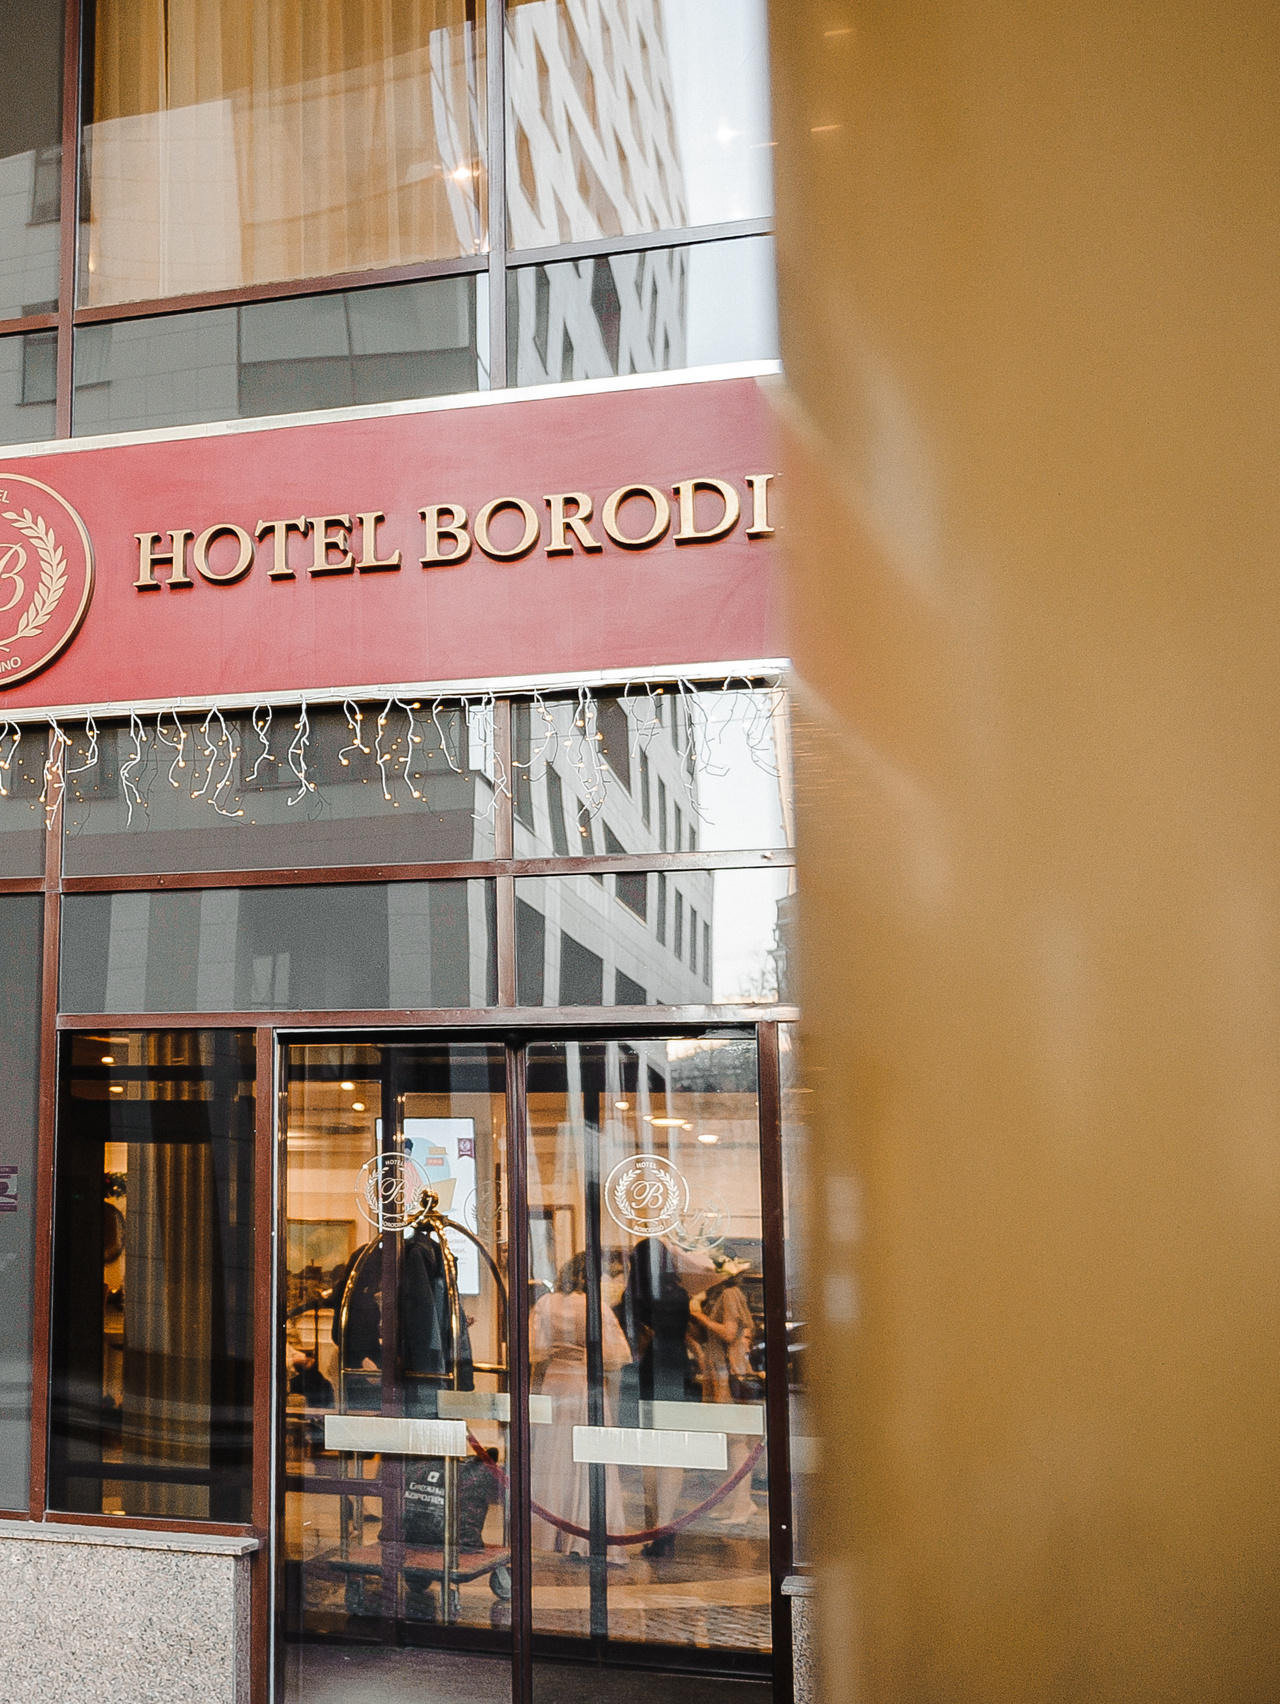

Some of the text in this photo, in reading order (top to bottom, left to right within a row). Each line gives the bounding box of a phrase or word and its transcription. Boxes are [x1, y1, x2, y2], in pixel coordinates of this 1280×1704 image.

[132, 472, 783, 591] HOTEL BORODI
[635, 1161, 658, 1169] HOTEL
[630, 1180, 664, 1209] B
